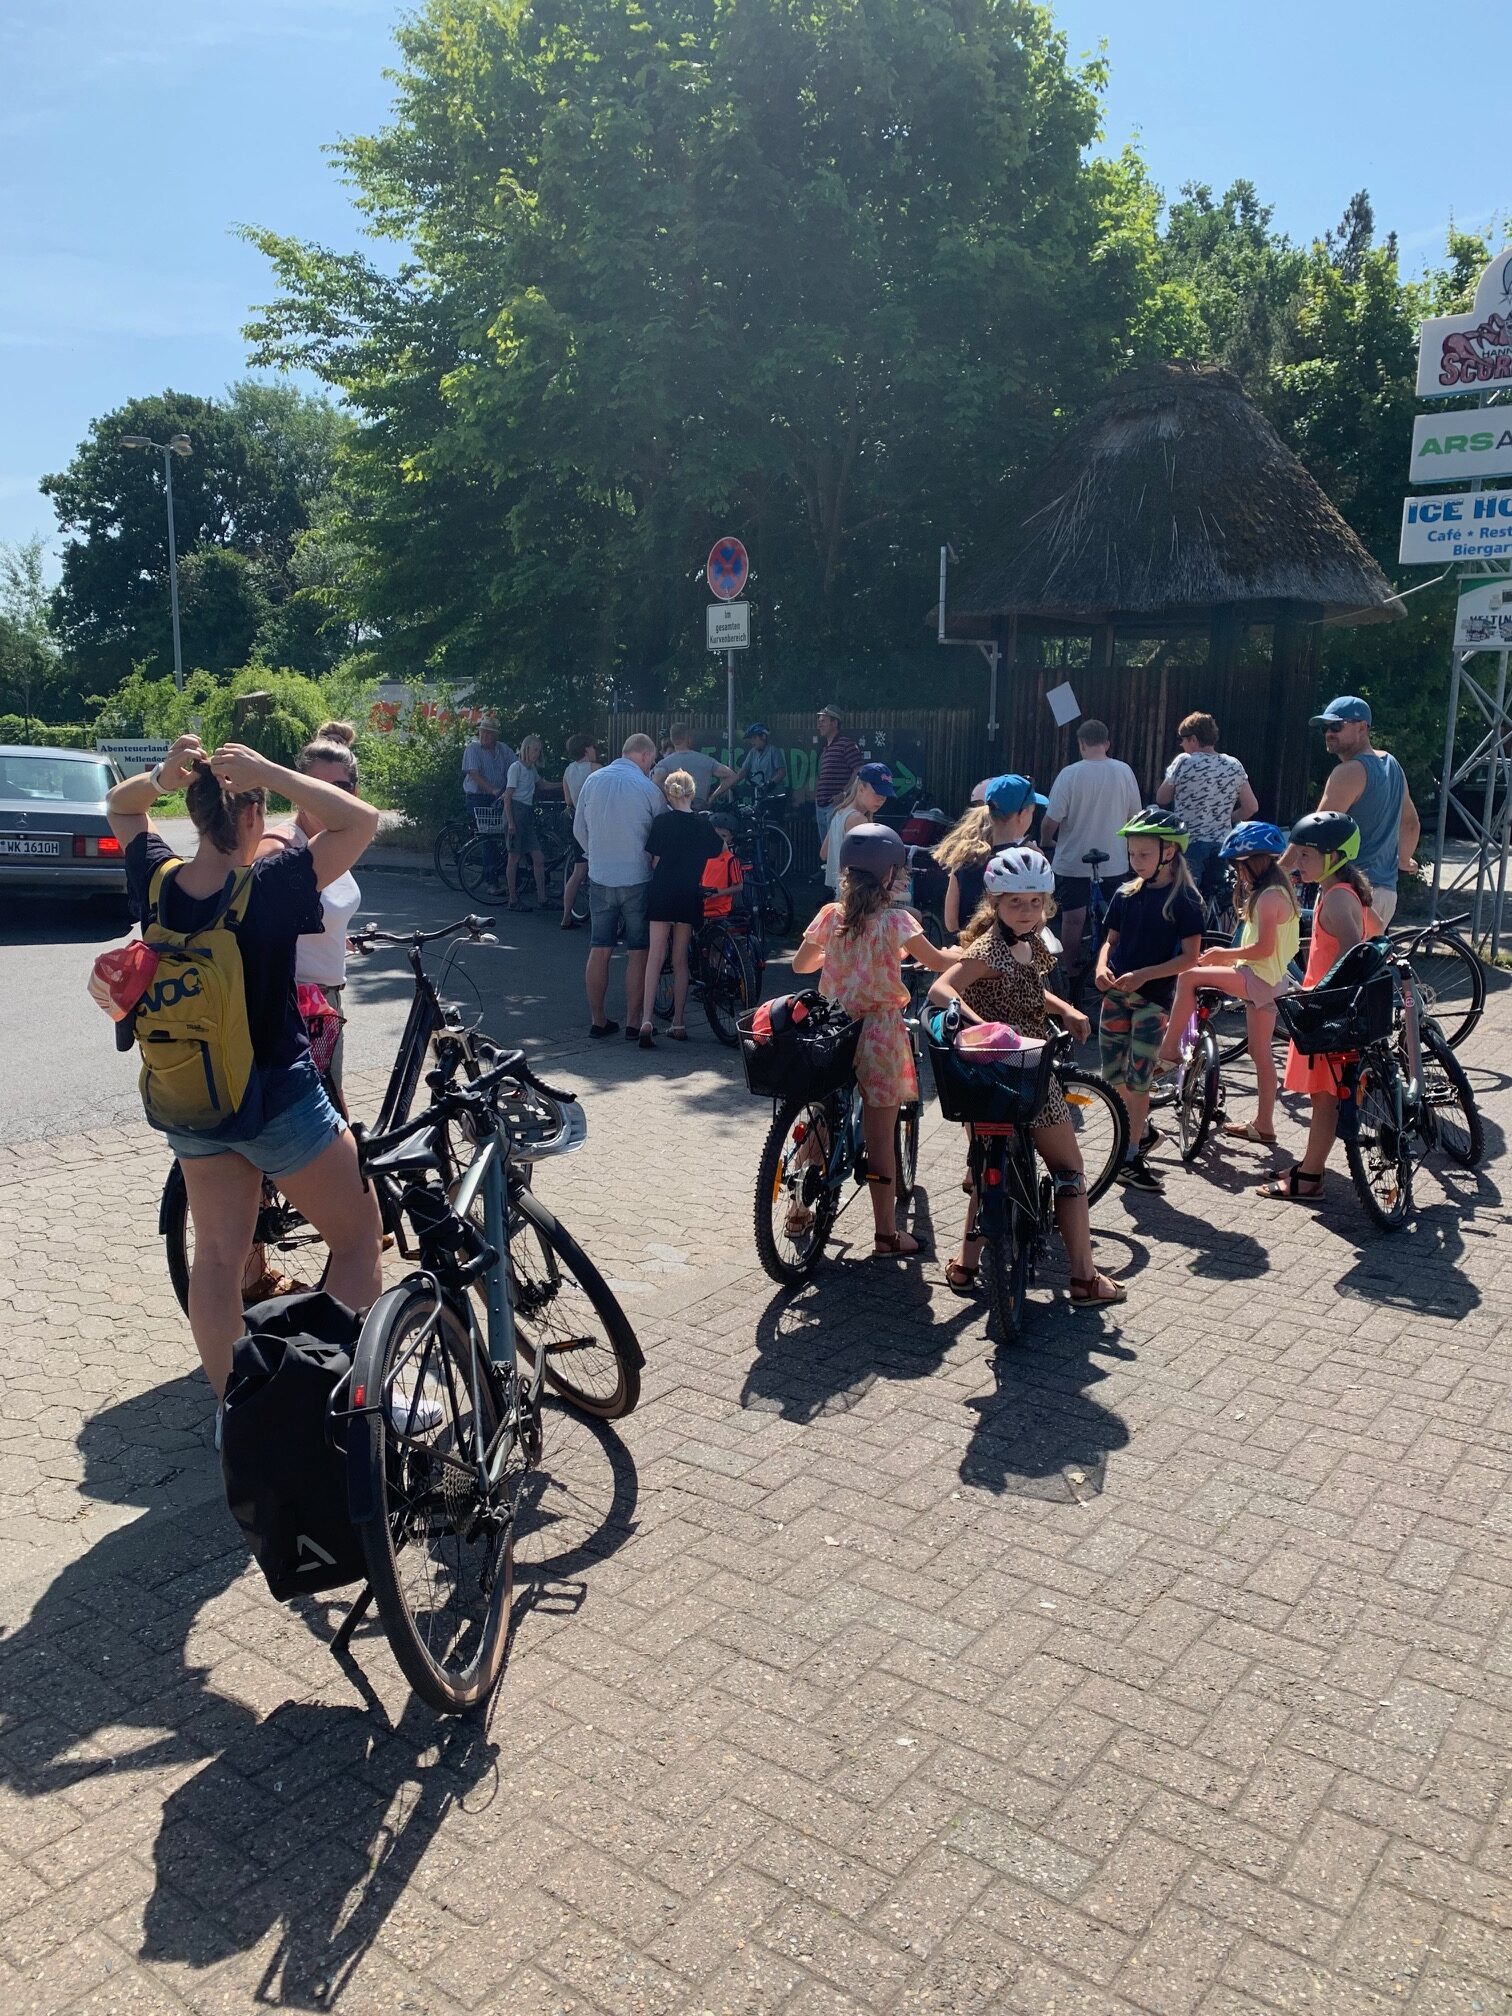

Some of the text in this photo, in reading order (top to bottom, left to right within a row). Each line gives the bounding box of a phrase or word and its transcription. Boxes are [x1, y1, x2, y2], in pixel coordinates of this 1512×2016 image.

[1482, 349, 1512, 358] HANN
[1407, 498, 1464, 524] ICE
[1427, 529, 1462, 542] Café
[715, 623, 741, 634] gesamten
[710, 633, 747, 643] Kurvenbereich
[100, 744, 169, 753] Abenteuerland
[124, 755, 167, 763] Mellendor
[7, 841, 59, 854] WK 1610H
